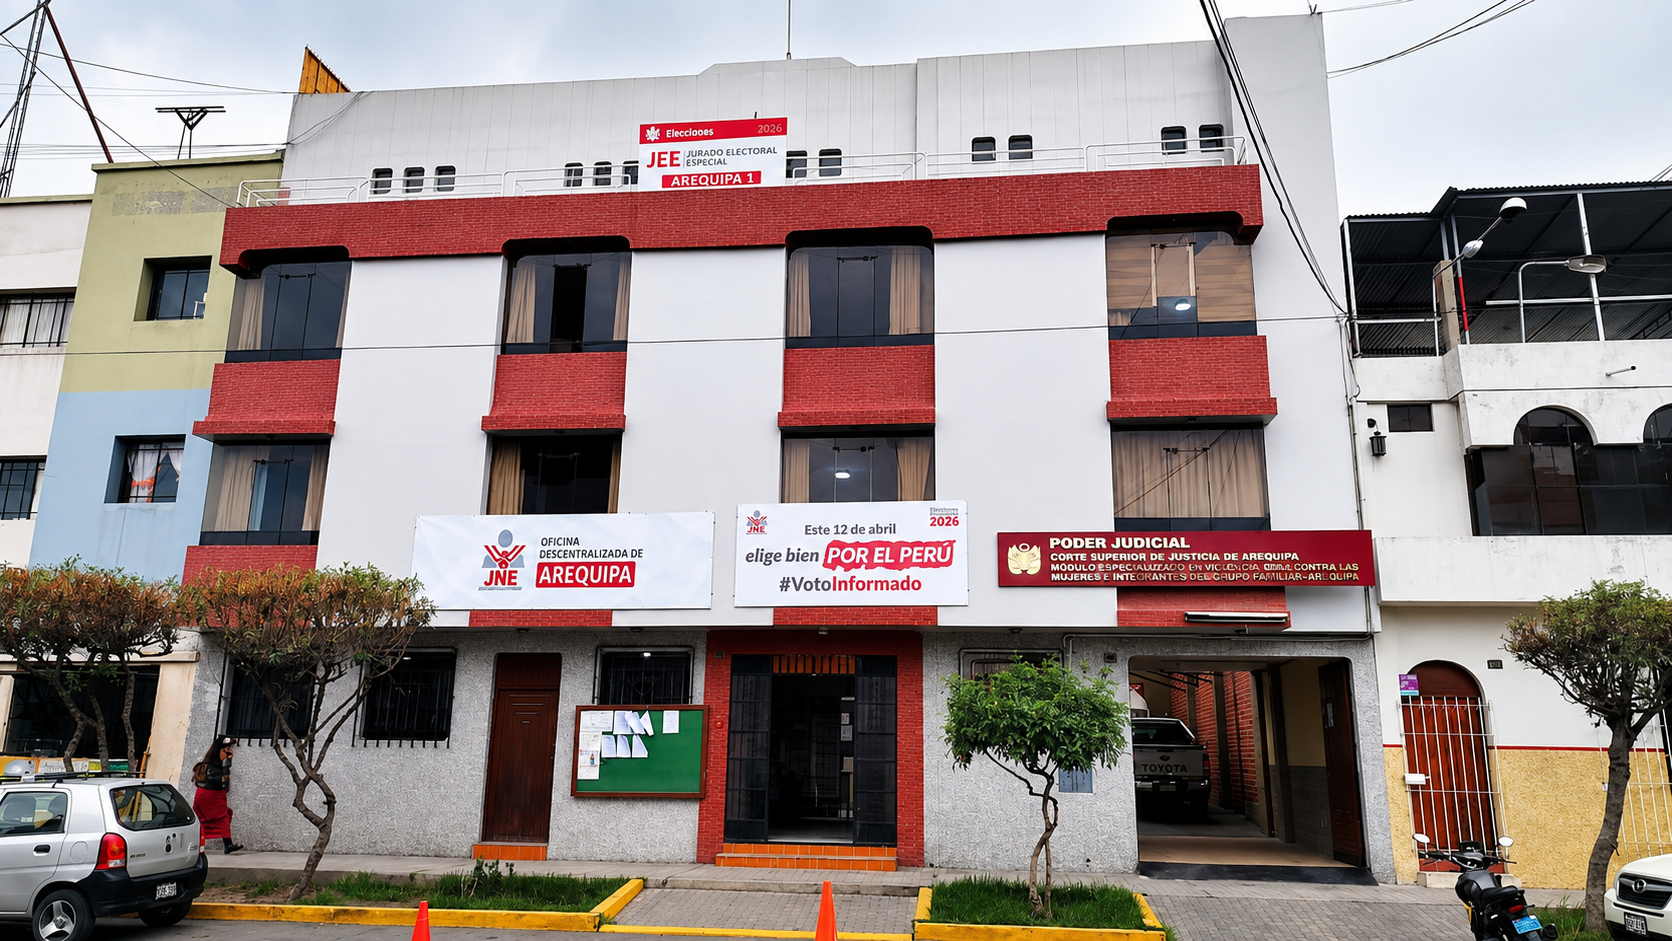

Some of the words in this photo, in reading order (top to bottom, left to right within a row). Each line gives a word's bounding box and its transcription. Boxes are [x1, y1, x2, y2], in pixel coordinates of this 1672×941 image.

[757, 123, 782, 134] 2026
[686, 148, 723, 158] JURADO
[726, 146, 777, 156] ELECTORAL
[646, 150, 681, 169] JEE
[686, 157, 727, 167] ESPECIAL
[670, 173, 742, 187] AREQUIPA
[746, 173, 754, 184] 1
[929, 516, 959, 527] 2026
[804, 524, 831, 536] Este
[833, 524, 848, 535] 12
[850, 523, 866, 535] de
[868, 523, 896, 535] abril
[541, 536, 580, 547] OFICINA
[1049, 537, 1107, 549] PODER
[1111, 536, 1191, 549] JUDICIAL
[539, 549, 628, 559] DESCENTRALIZADA
[630, 548, 644, 559] DE
[745, 547, 783, 566] elige
[785, 546, 819, 563] bien
[826, 546, 868, 564] POR
[873, 546, 895, 564] EL
[899, 542, 953, 563] PERÚ
[1050, 552, 1087, 562] CORTE
[1090, 552, 1146, 561] SUPERIOR
[1150, 552, 1165, 561] DE
[1167, 552, 1220, 561] JUSTICIA
[1223, 552, 1239, 561] DE
[1241, 552, 1300, 562] AREQUIPA
[1293, 563, 1336, 571] CONTRA
[1339, 563, 1359, 571] LAS
[484, 569, 518, 586] JNE
[538, 565, 632, 585] AREQUIPA
[1051, 572, 1101, 581] MUJERES
[1104, 572, 1110, 581] E
[779, 575, 922, 592] #VotoInformado
[1141, 763, 1188, 773] TOYOTA
